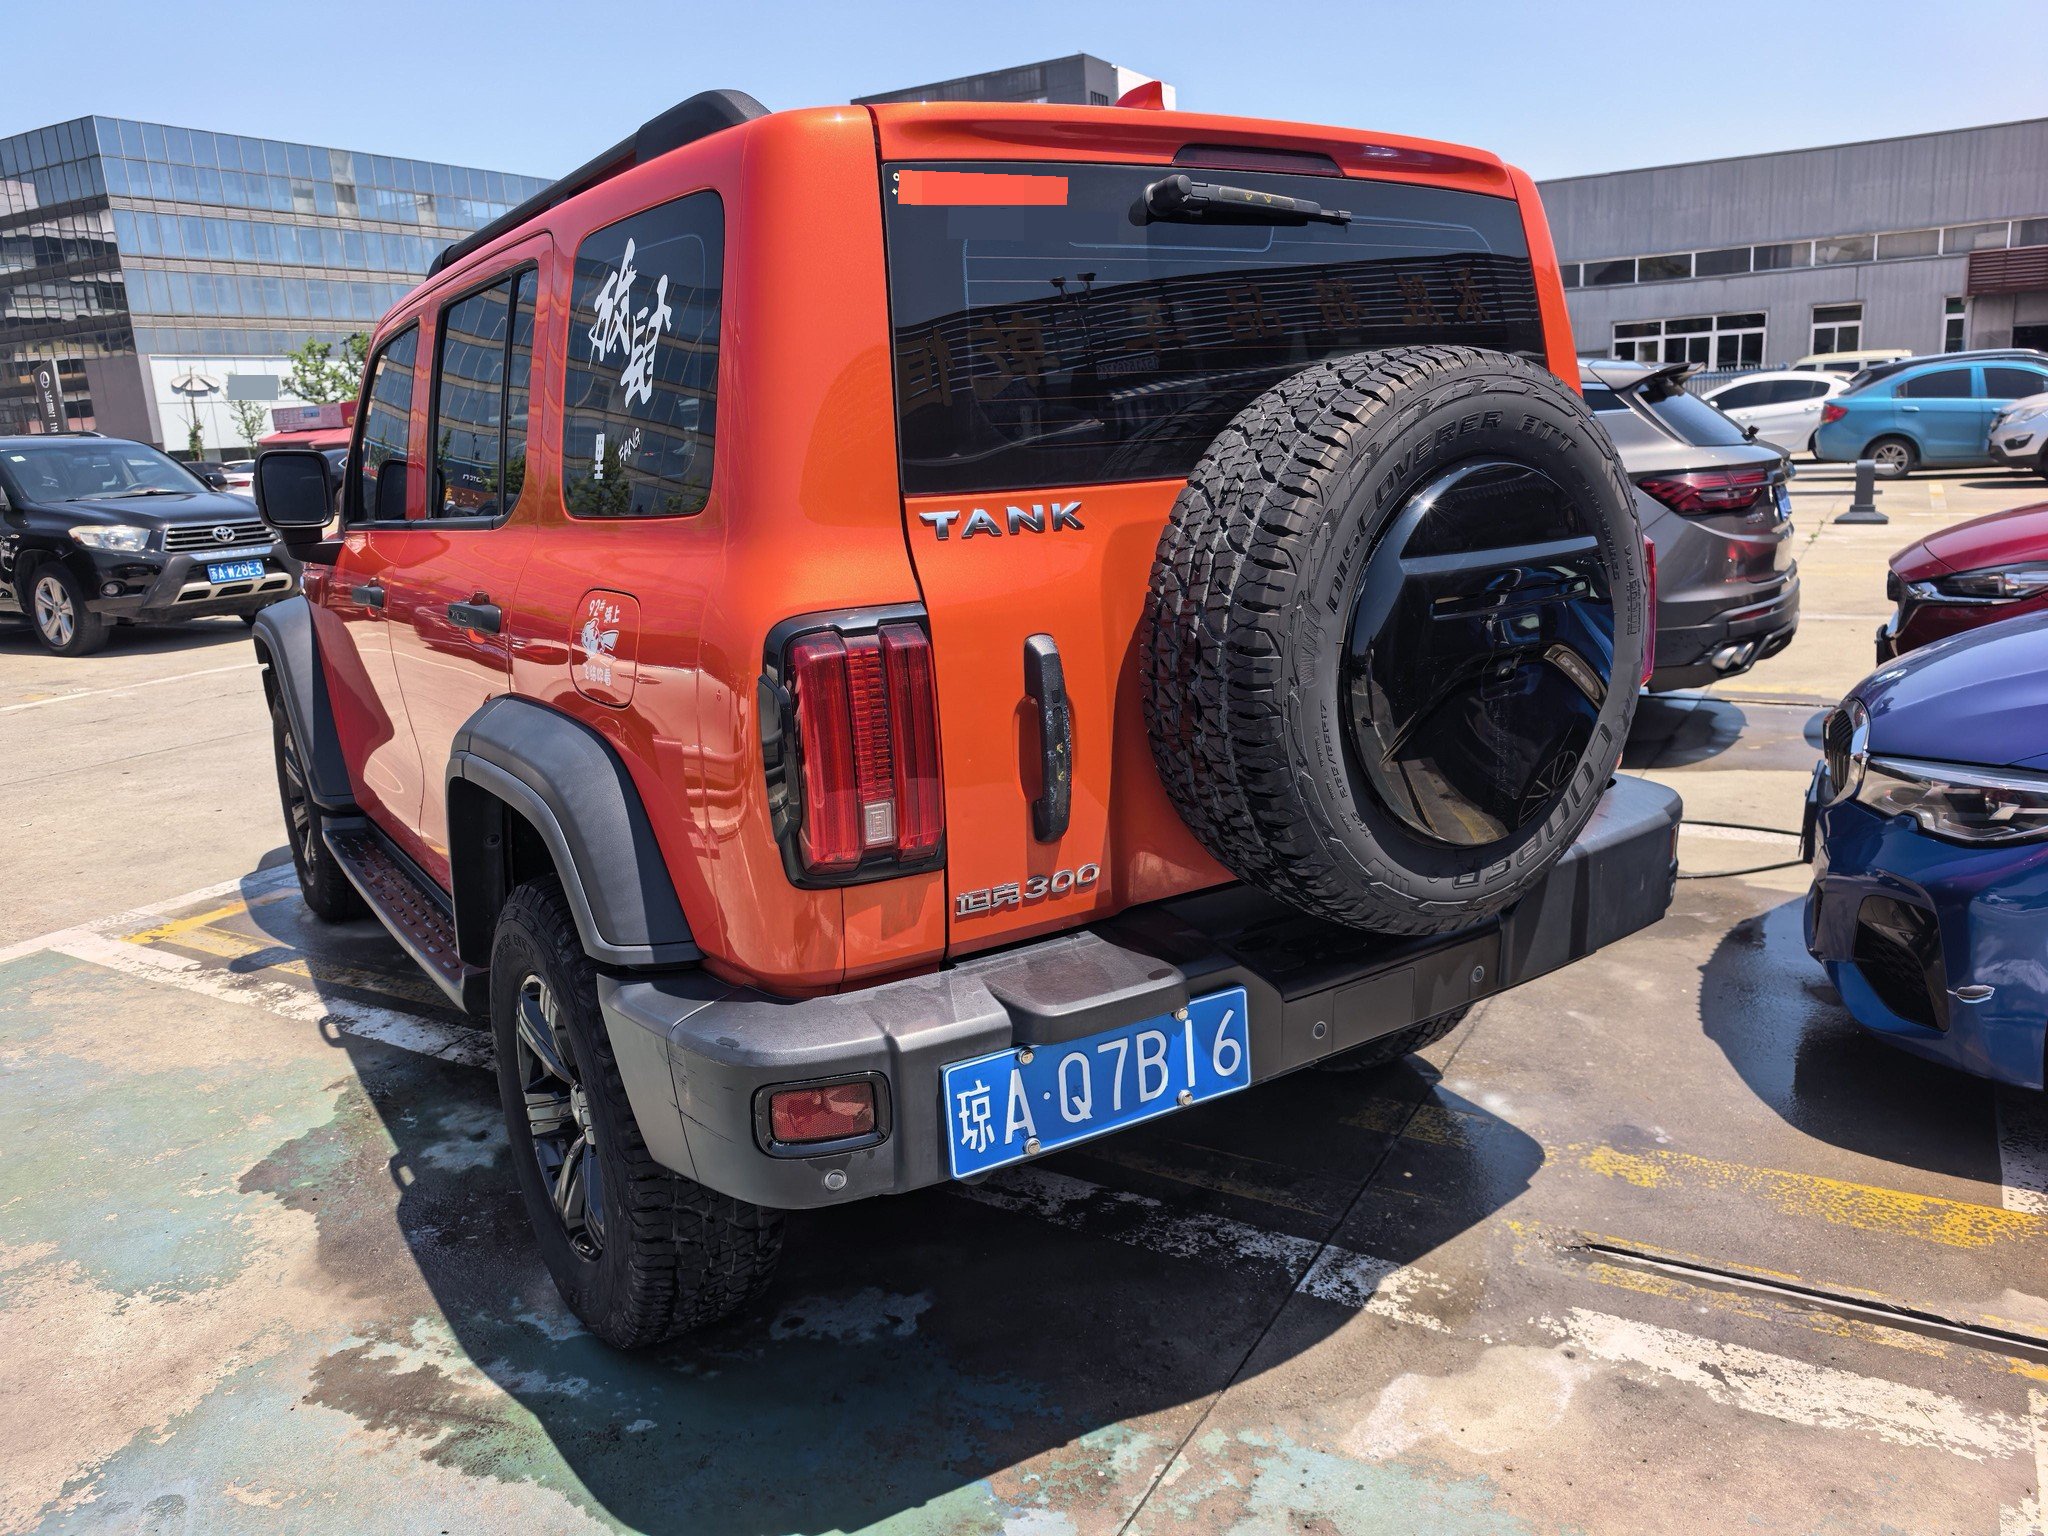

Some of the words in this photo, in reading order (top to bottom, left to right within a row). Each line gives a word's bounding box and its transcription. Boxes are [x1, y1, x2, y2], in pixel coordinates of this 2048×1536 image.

[919, 501, 1085, 540] TANK
[1325, 409, 1503, 615] DISCOVERER
[1452, 721, 1613, 890] COOPER
[955, 863, 1101, 918] 坦克300
[957, 1009, 1242, 1155] 琼A·Q7B16
